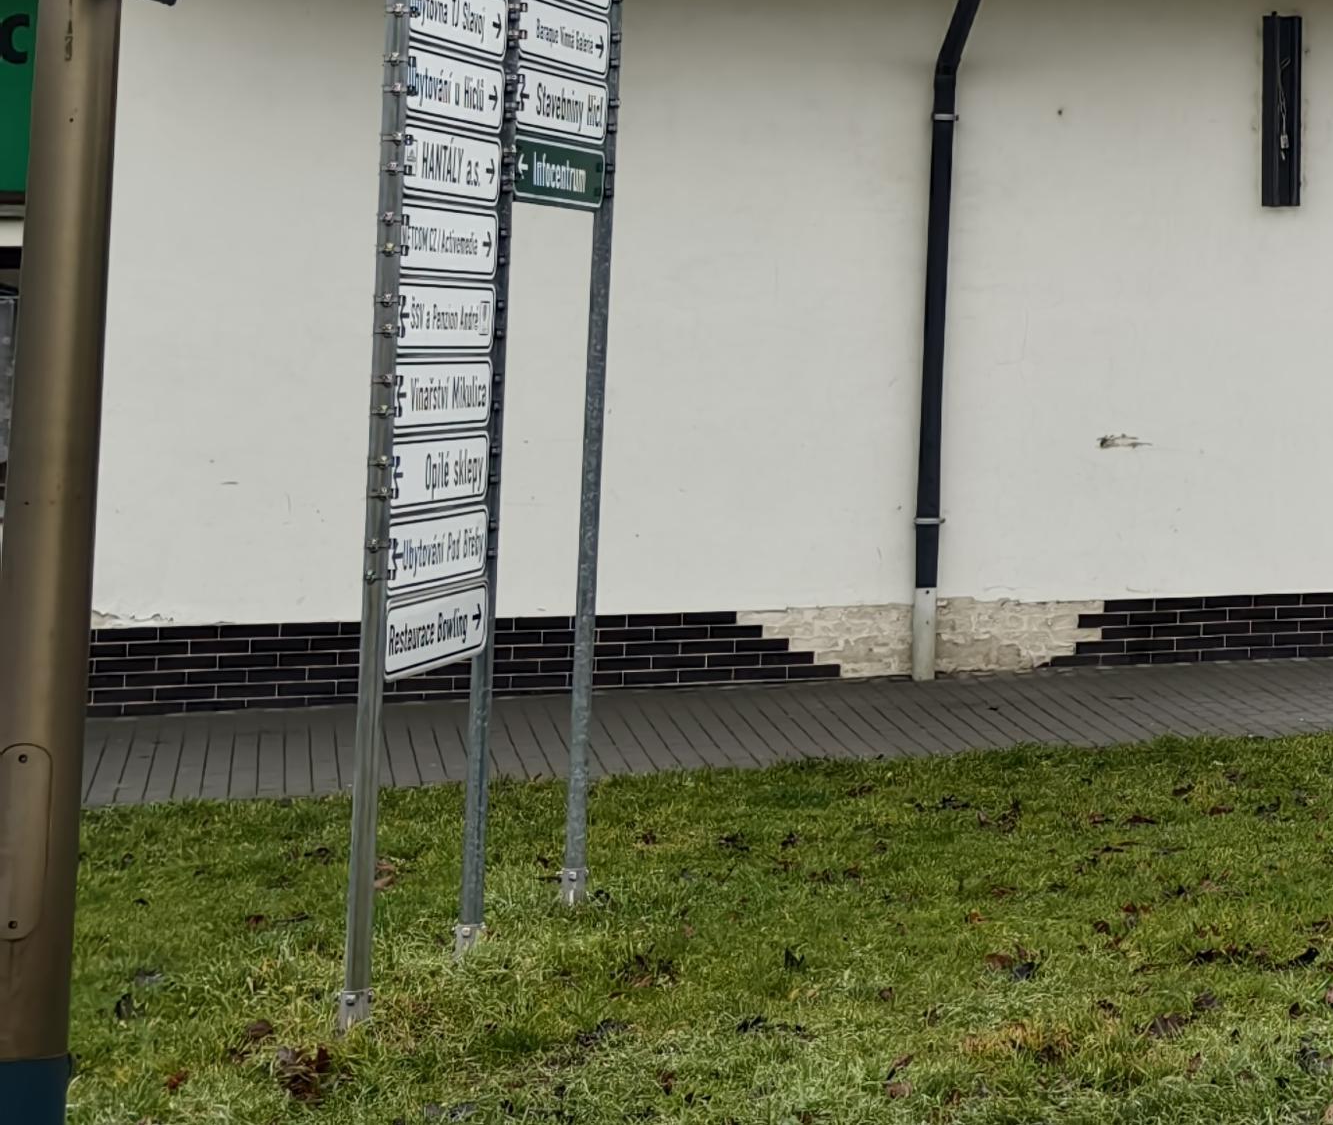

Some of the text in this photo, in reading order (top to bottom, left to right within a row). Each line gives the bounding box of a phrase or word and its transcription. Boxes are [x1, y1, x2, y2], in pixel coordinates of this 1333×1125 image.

[462, 1, 486, 43] Slavoj
[408, 62, 453, 107] Ubytování
[454, 83, 460, 106] u
[536, 82, 584, 133] Stavebniny
[421, 137, 481, 187] HANTÁLY a.s.
[533, 150, 587, 193] Infocentrum
[426, 311, 431, 330] a
[432, 303, 459, 330] Penzion
[411, 375, 487, 412] Vinařství Mikulica
[425, 449, 484, 500] Opilé sklepy
[402, 532, 446, 577] Ubytování
[446, 530, 461, 562] Pod
[388, 607, 468, 657] Restaurace Bowling
